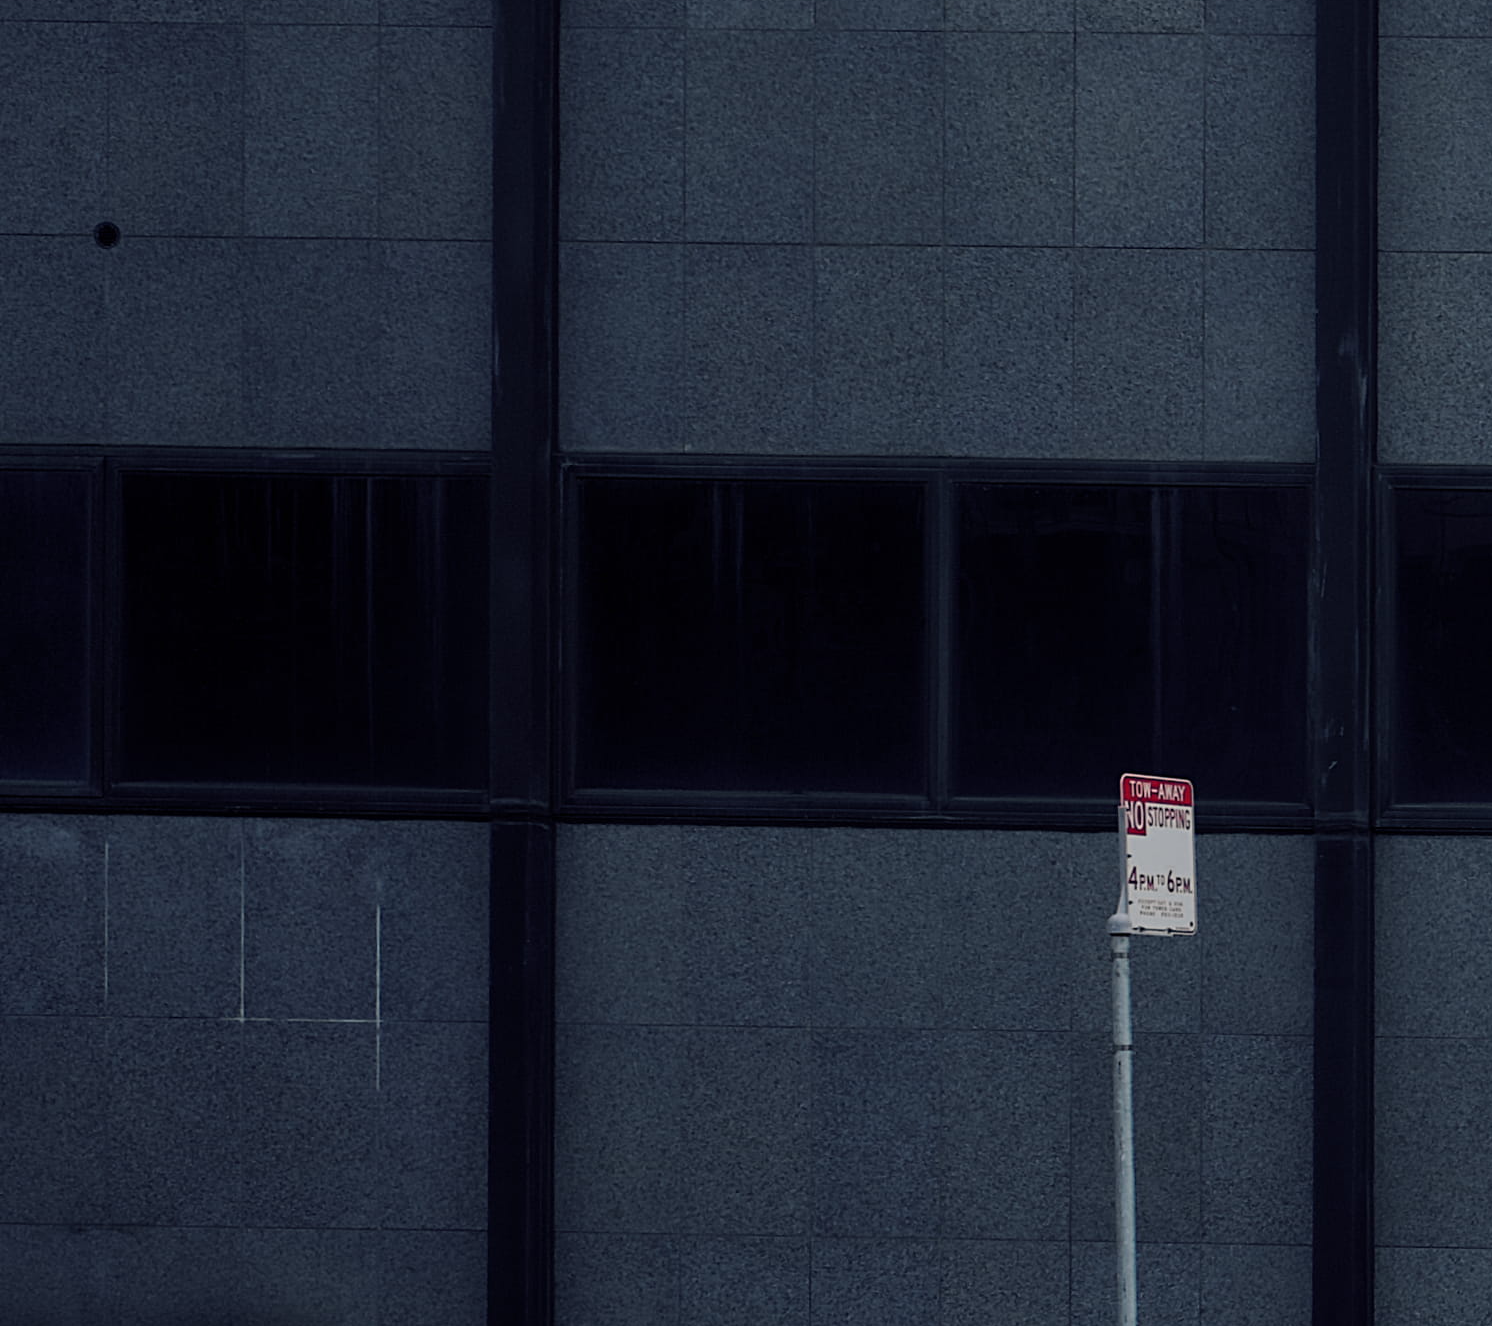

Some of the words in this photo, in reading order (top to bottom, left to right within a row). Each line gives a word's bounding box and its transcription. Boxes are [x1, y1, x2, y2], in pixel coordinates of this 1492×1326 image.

[1128, 780, 1186, 802] TOW-AWAY
[1124, 800, 1145, 831] NO
[1147, 805, 1191, 831] STOPPING
